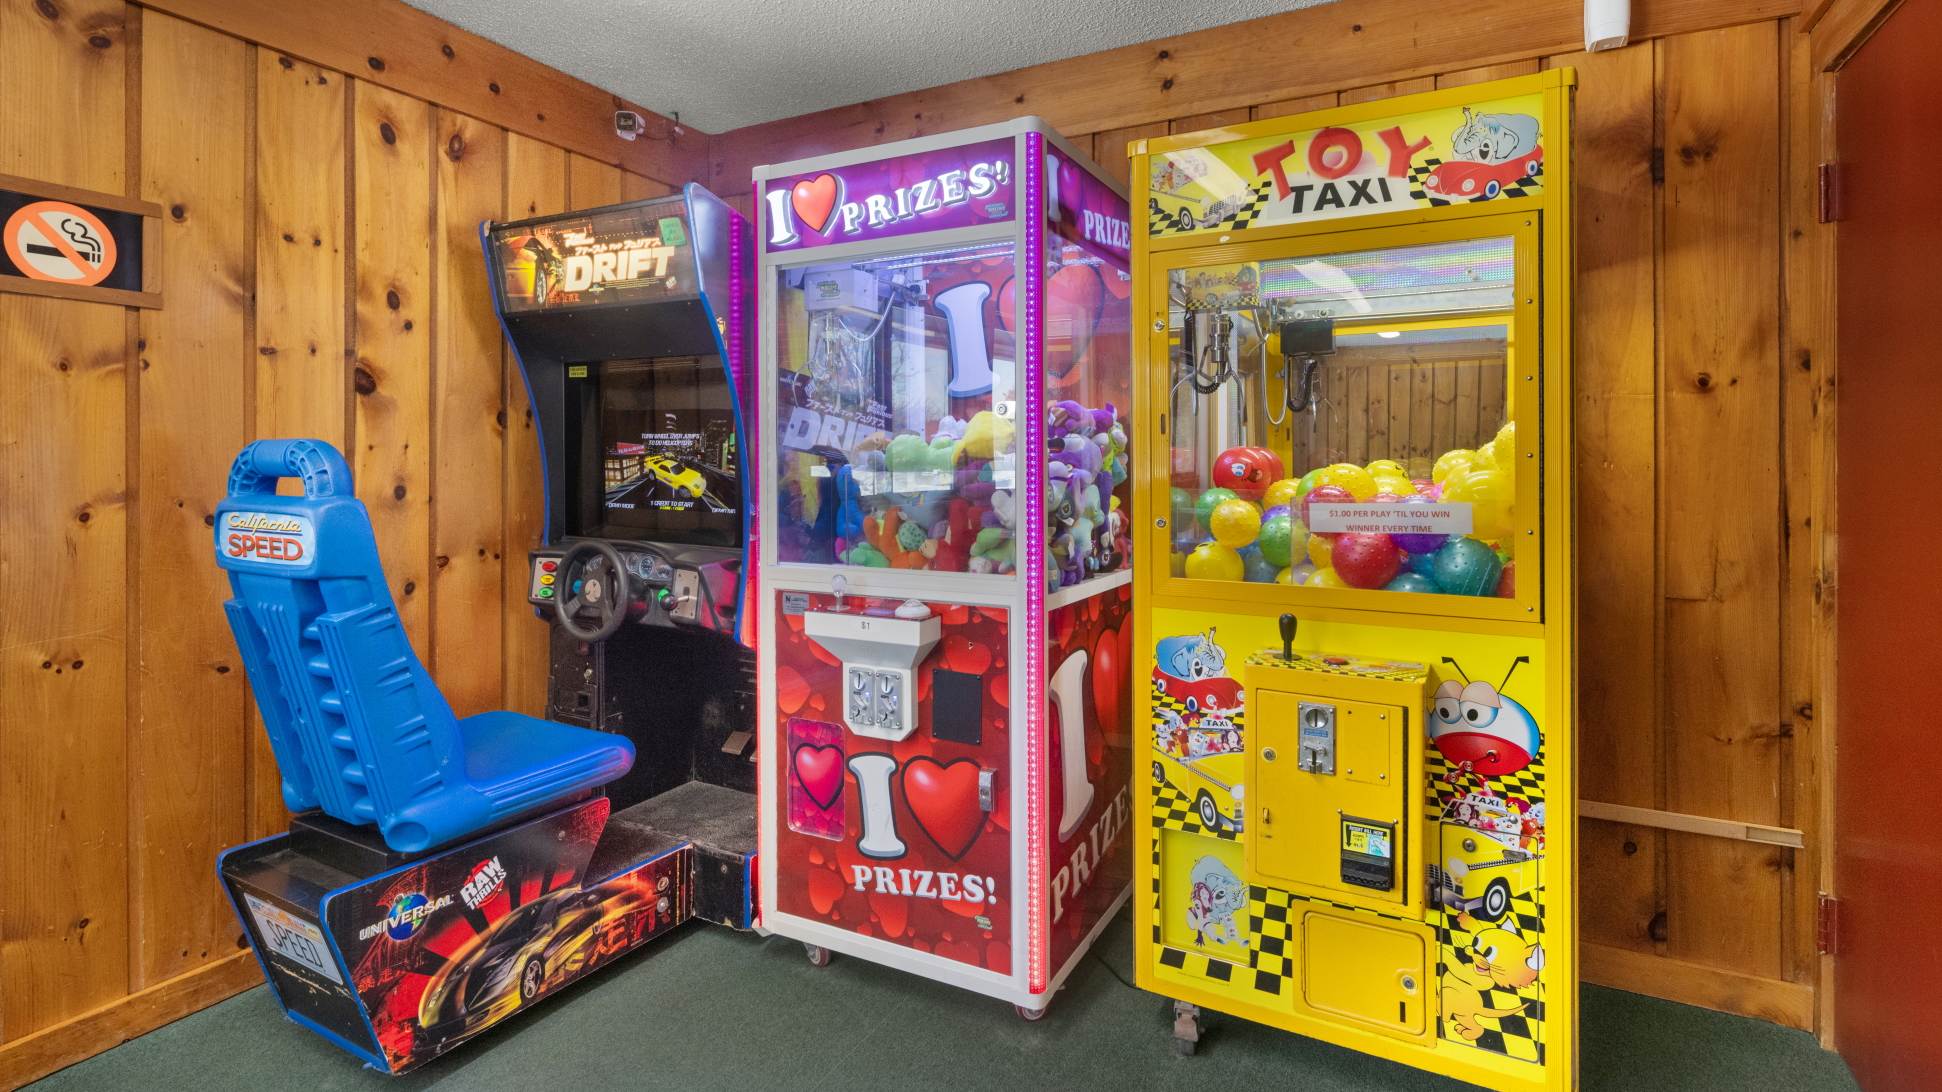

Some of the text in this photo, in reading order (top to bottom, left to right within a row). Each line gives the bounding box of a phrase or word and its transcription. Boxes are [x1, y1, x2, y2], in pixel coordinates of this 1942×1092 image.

[1251, 125, 1432, 202] TOY
[766, 160, 1009, 246] I PRIZES!
[1290, 177, 1393, 214] TAXI
[565, 246, 675, 292] DRIFT
[228, 513, 302, 535] California
[1329, 510, 1351, 518] $1.00
[1353, 510, 1368, 518] PER
[1371, 510, 1390, 518] PLAY
[1410, 510, 1429, 518] YOU
[1431, 510, 1450, 518] WIN
[1346, 525, 1432, 533] WINNER EVERY TIME
[228, 533, 304, 562] SPEED
[861, 621, 870, 630] $1
[1206, 719, 1229, 727] TAXI
[1049, 649, 1094, 843] I
[848, 751, 907, 860] I
[1471, 795, 1499, 807] TAXI
[460, 855, 501, 903] RAW
[467, 868, 507, 910] THRILLS
[851, 864, 997, 904] PRIZES!
[360, 894, 454, 941] UNIVERSAL
[266, 920, 323, 968] SPEED
